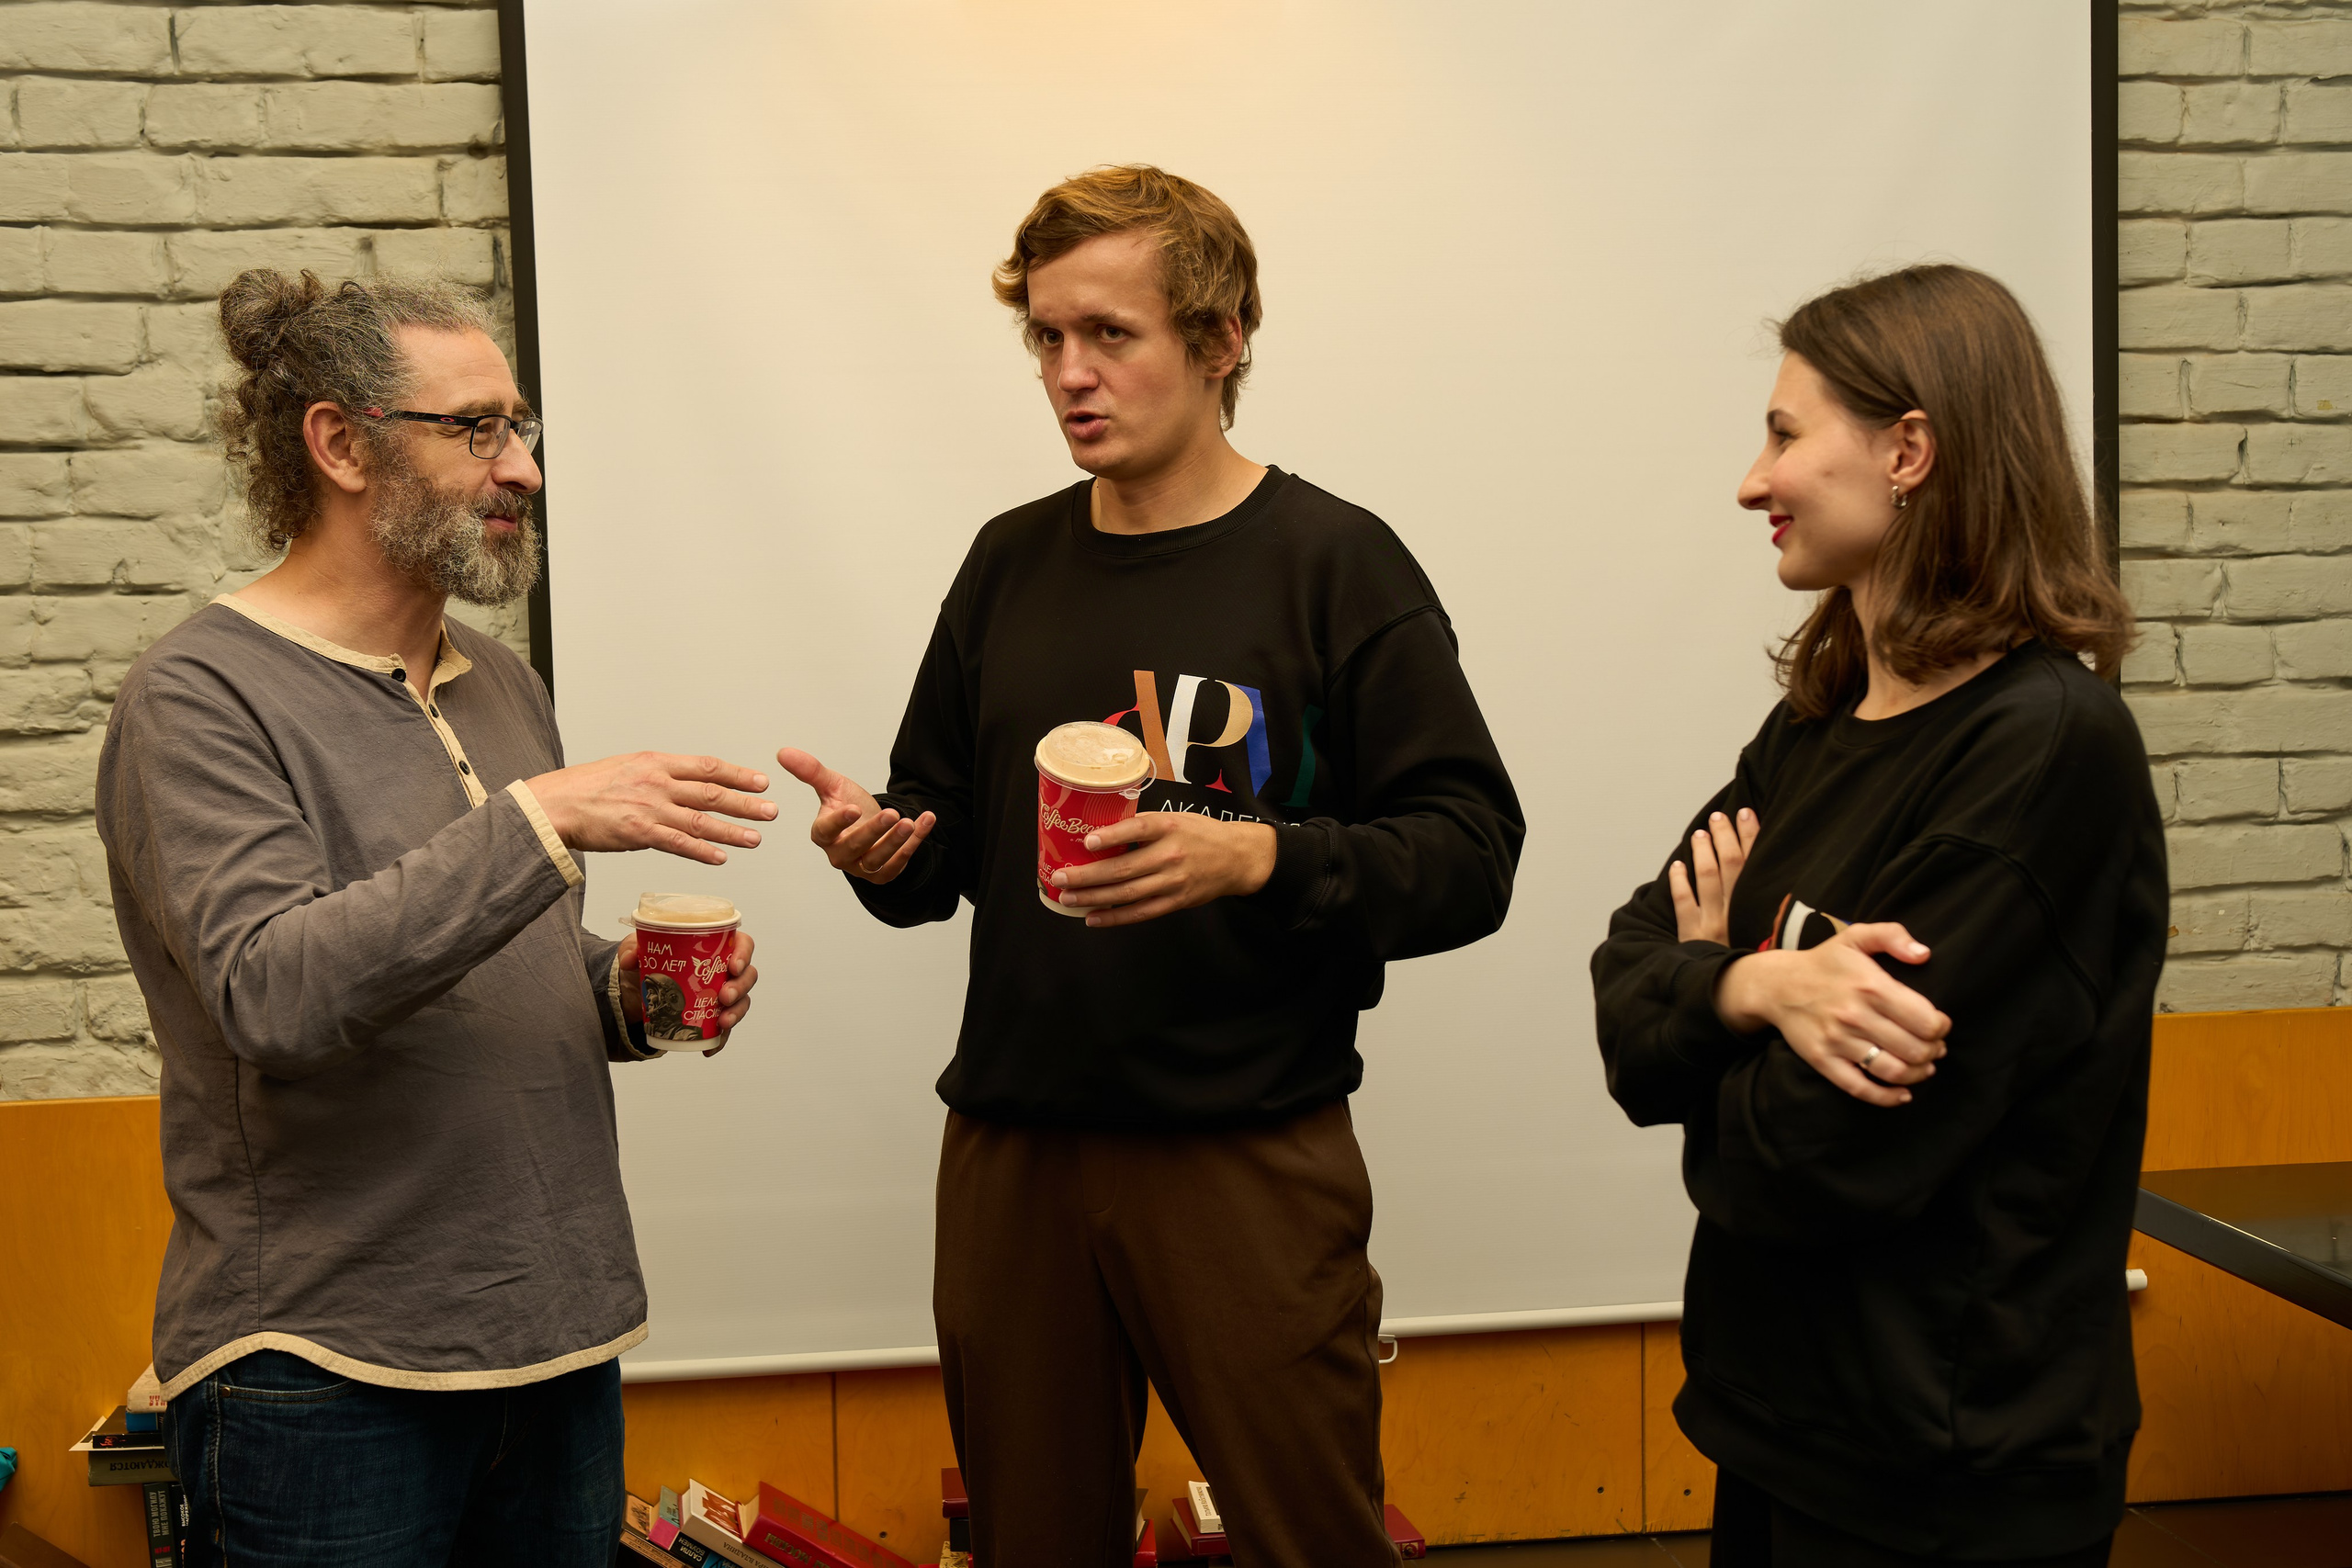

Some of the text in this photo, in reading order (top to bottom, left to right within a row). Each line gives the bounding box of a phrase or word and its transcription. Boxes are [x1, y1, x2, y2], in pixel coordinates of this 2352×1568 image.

[1067, 818, 1105, 834] Bea
[647, 941, 673, 955] НАМ
[662, 959, 686, 972] ЛЕТ
[157, 1490, 168, 1521] ПОКАЖУТ
[149, 1492, 161, 1538] ТВОЮ МОГИЛУ
[161, 1521, 169, 1536] МНЕ
[678, 1537, 706, 1556] БОУМЕН
[680, 1546, 703, 1562] САЛЛИ
